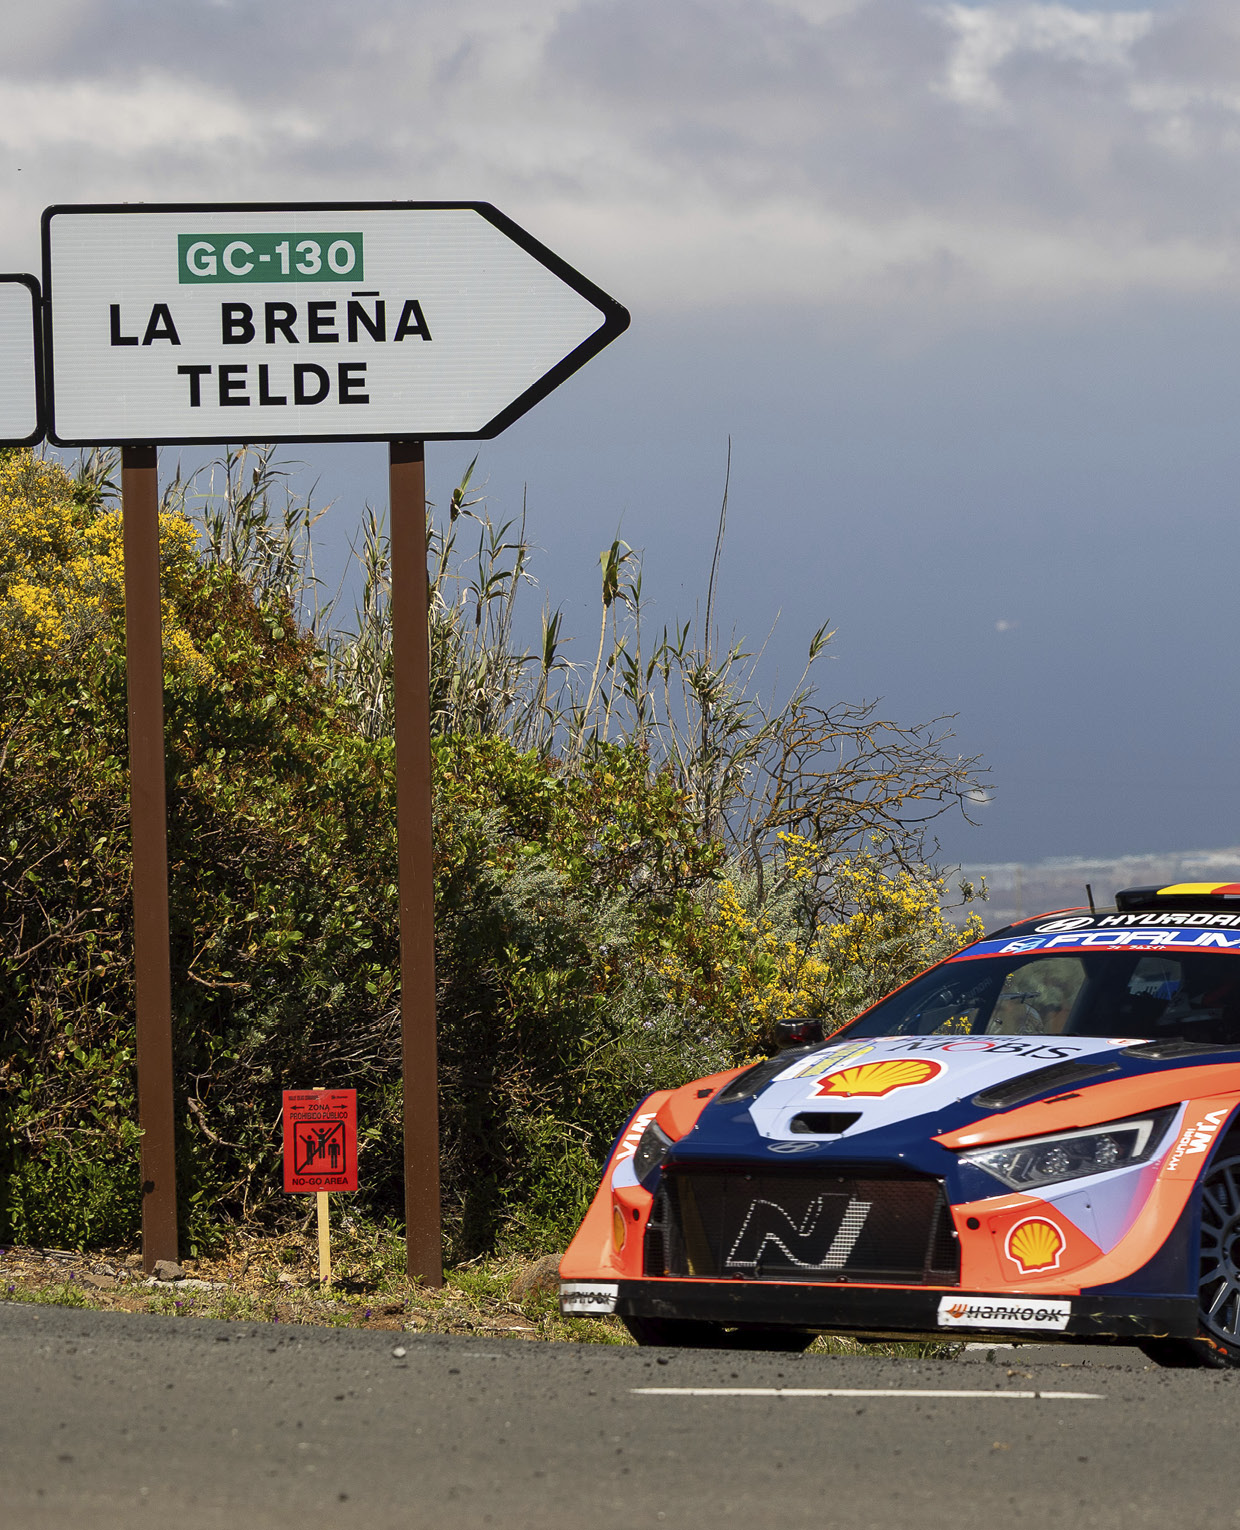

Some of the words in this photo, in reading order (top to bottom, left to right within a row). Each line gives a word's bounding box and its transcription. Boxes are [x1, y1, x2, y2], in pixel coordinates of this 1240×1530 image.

[185, 240, 357, 277] GC-130
[110, 303, 182, 346] LA
[222, 291, 432, 344] BREÑA
[178, 362, 370, 407] TELDE
[888, 1041, 1083, 1059] MOBIS
[616, 1112, 658, 1161] WIA
[1166, 1128, 1197, 1171] HYUNDAI
[1185, 1108, 1229, 1155] WIA
[292, 1178, 322, 1186] NO-GO
[324, 1177, 349, 1185] AREA
